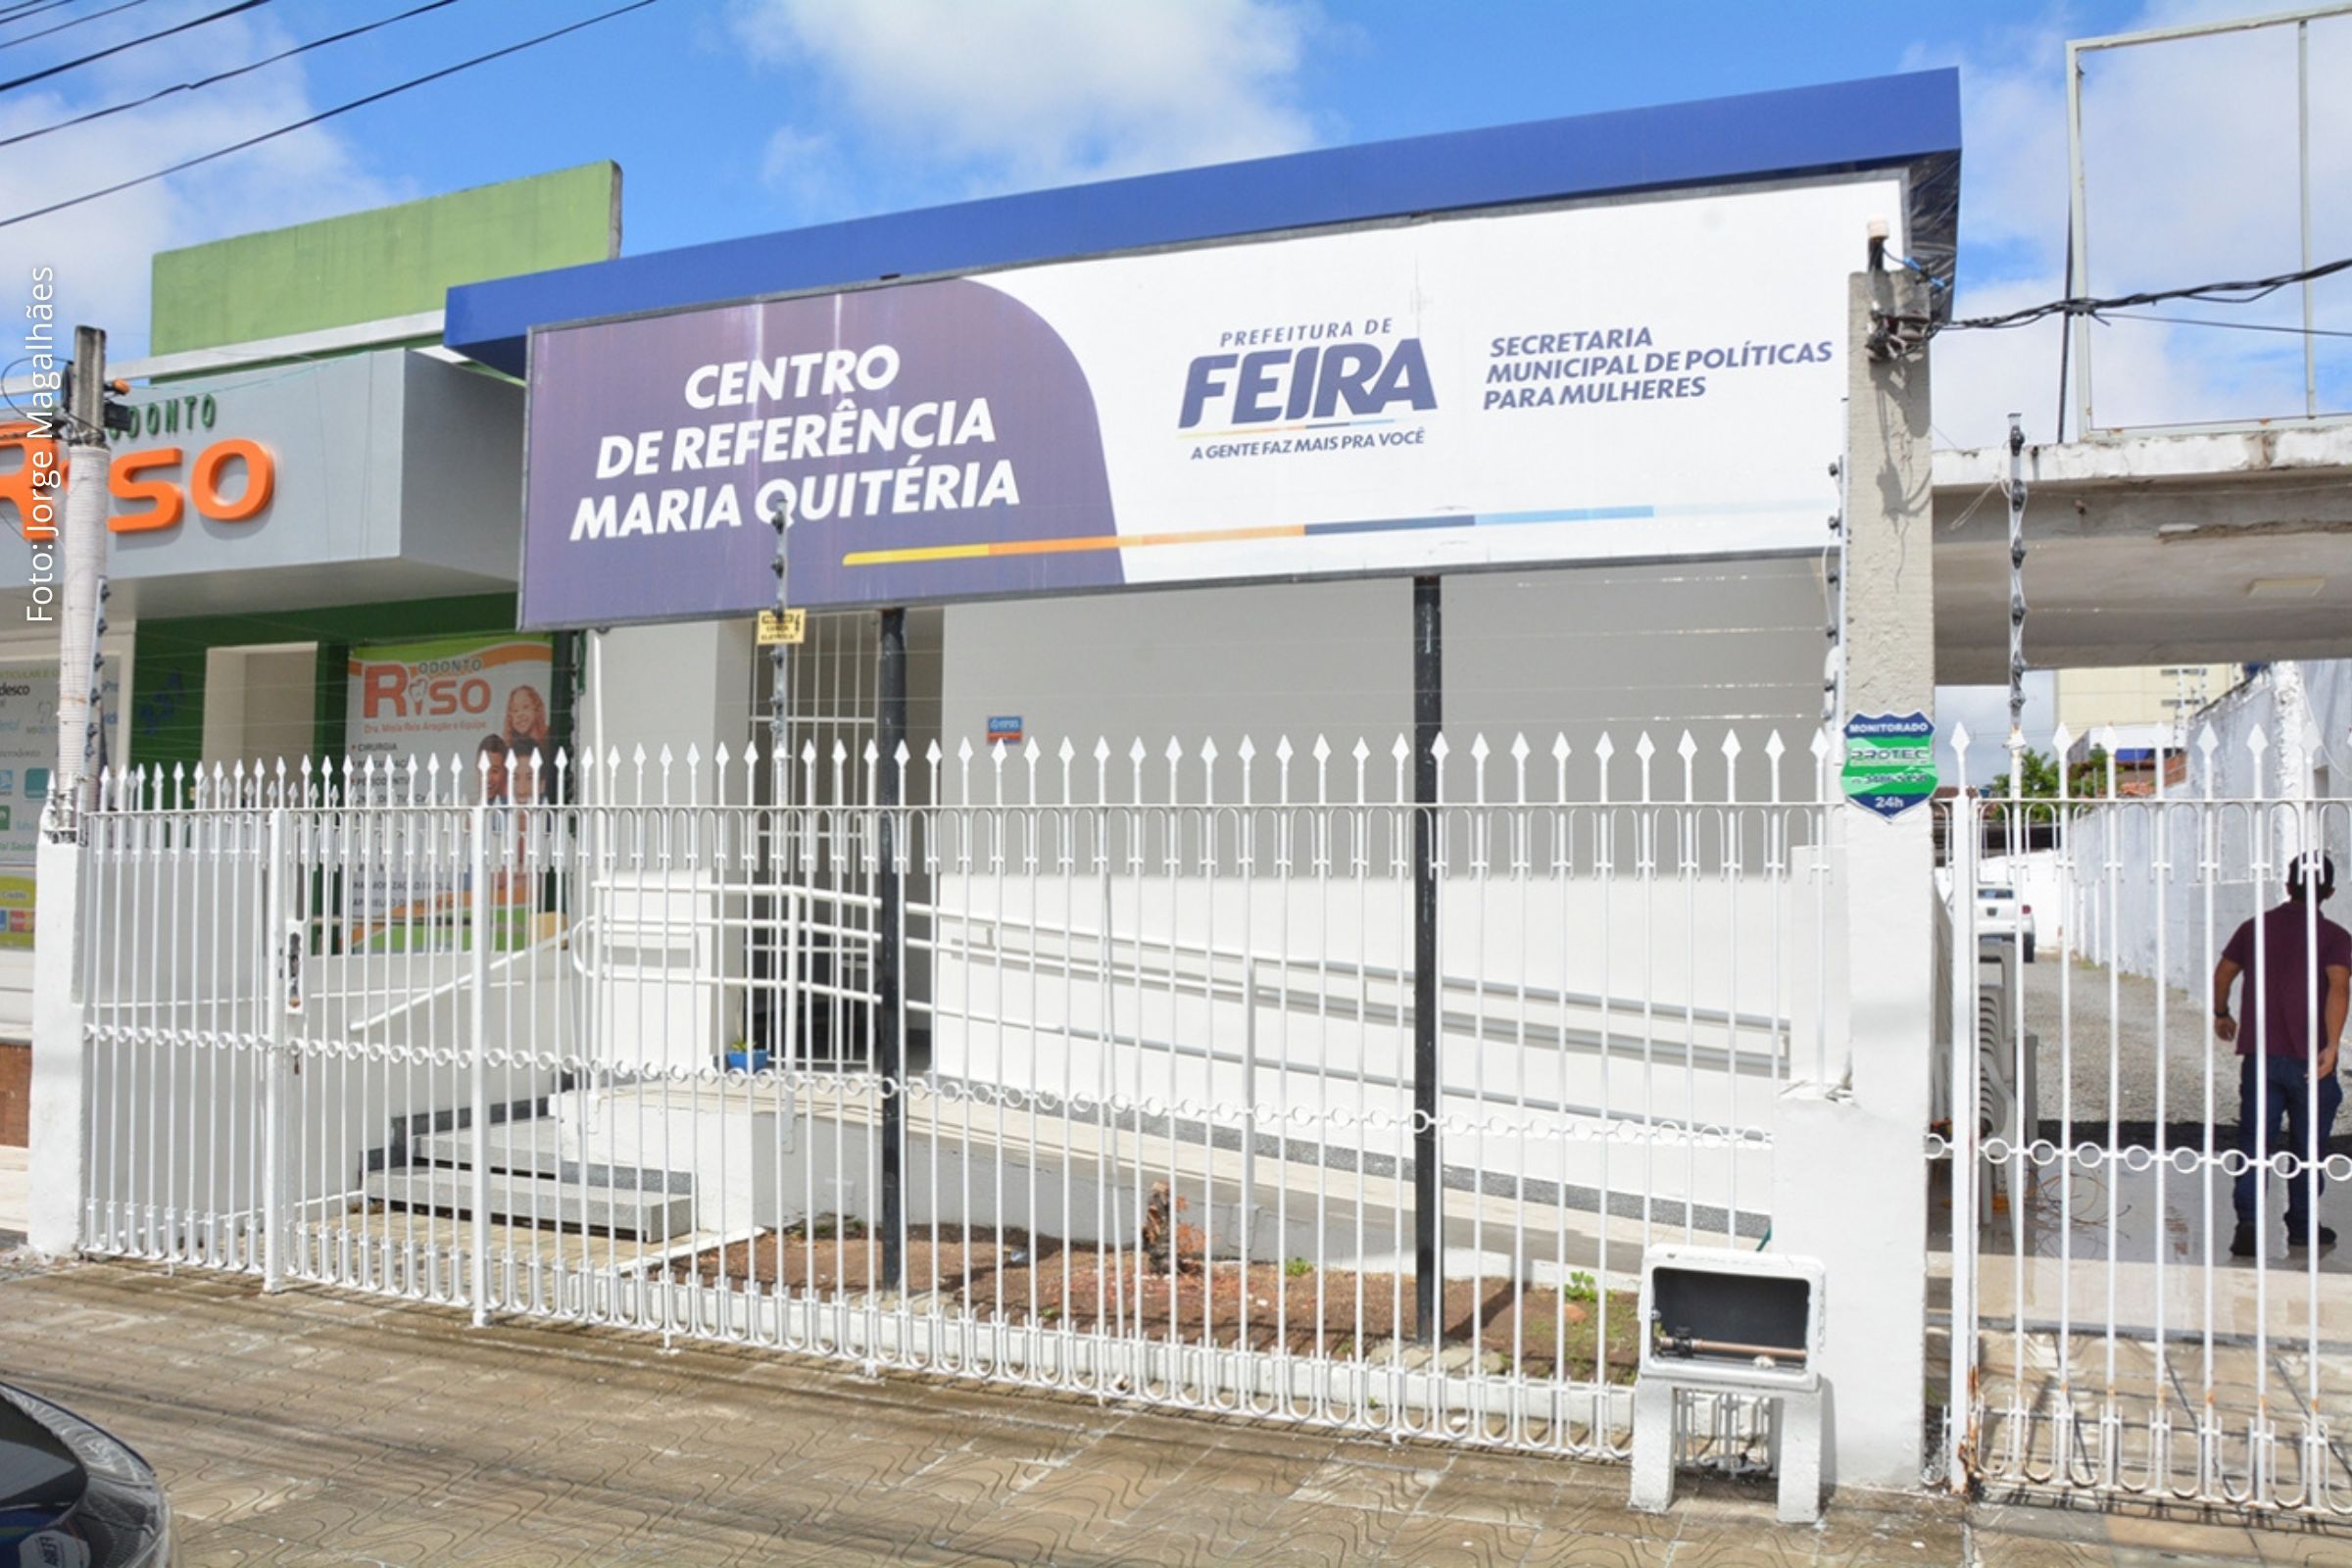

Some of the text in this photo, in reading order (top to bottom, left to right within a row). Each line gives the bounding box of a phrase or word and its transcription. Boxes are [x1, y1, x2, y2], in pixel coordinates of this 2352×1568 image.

[1220, 318, 1393, 347] PREFEITURA DE
[1490, 326, 1653, 358] SECRETARIA
[685, 344, 901, 410] CENTRO
[1486, 341, 1833, 384] MUNICIPAL DE POLÍTICAS
[1178, 337, 1438, 429] FEIRA
[1483, 375, 1706, 411] PARA MULHERES
[109, 393, 216, 440] DONTO
[595, 397, 997, 479] DE REFERÊNCIA
[1191, 426, 1426, 460] A GENTE FAZ MAIS PRA VOCÊ
[569, 454, 1020, 541] MARIA QUITÉRIA
[417, 659, 482, 674] ODONTO
[1848, 722, 1929, 733] MONITORADO
[1875, 796, 1903, 808] 24h
